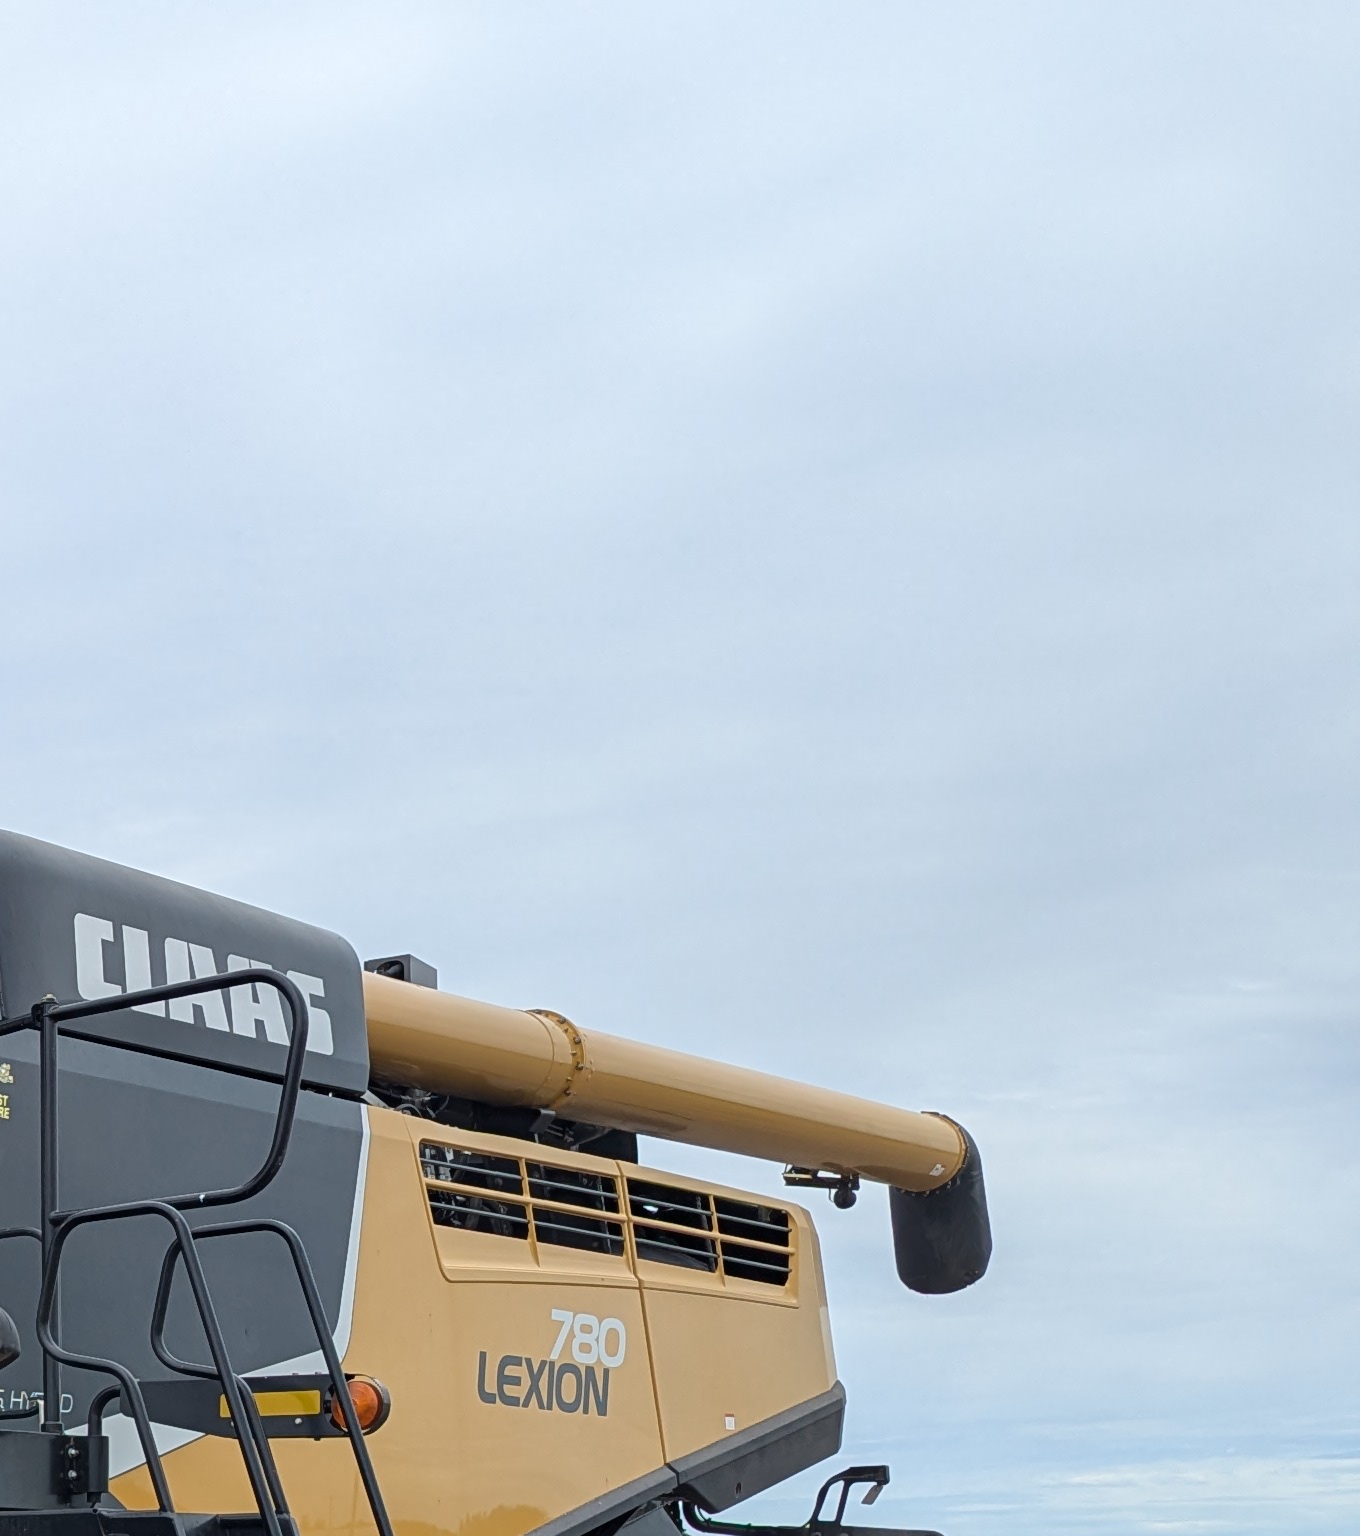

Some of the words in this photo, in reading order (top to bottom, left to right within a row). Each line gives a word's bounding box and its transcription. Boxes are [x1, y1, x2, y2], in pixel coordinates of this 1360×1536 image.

[75, 912, 334, 1056] CLAAS
[549, 1308, 627, 1368] 780
[10, 1390, 73, 1413] HYD
[477, 1350, 610, 1417] LEXION
